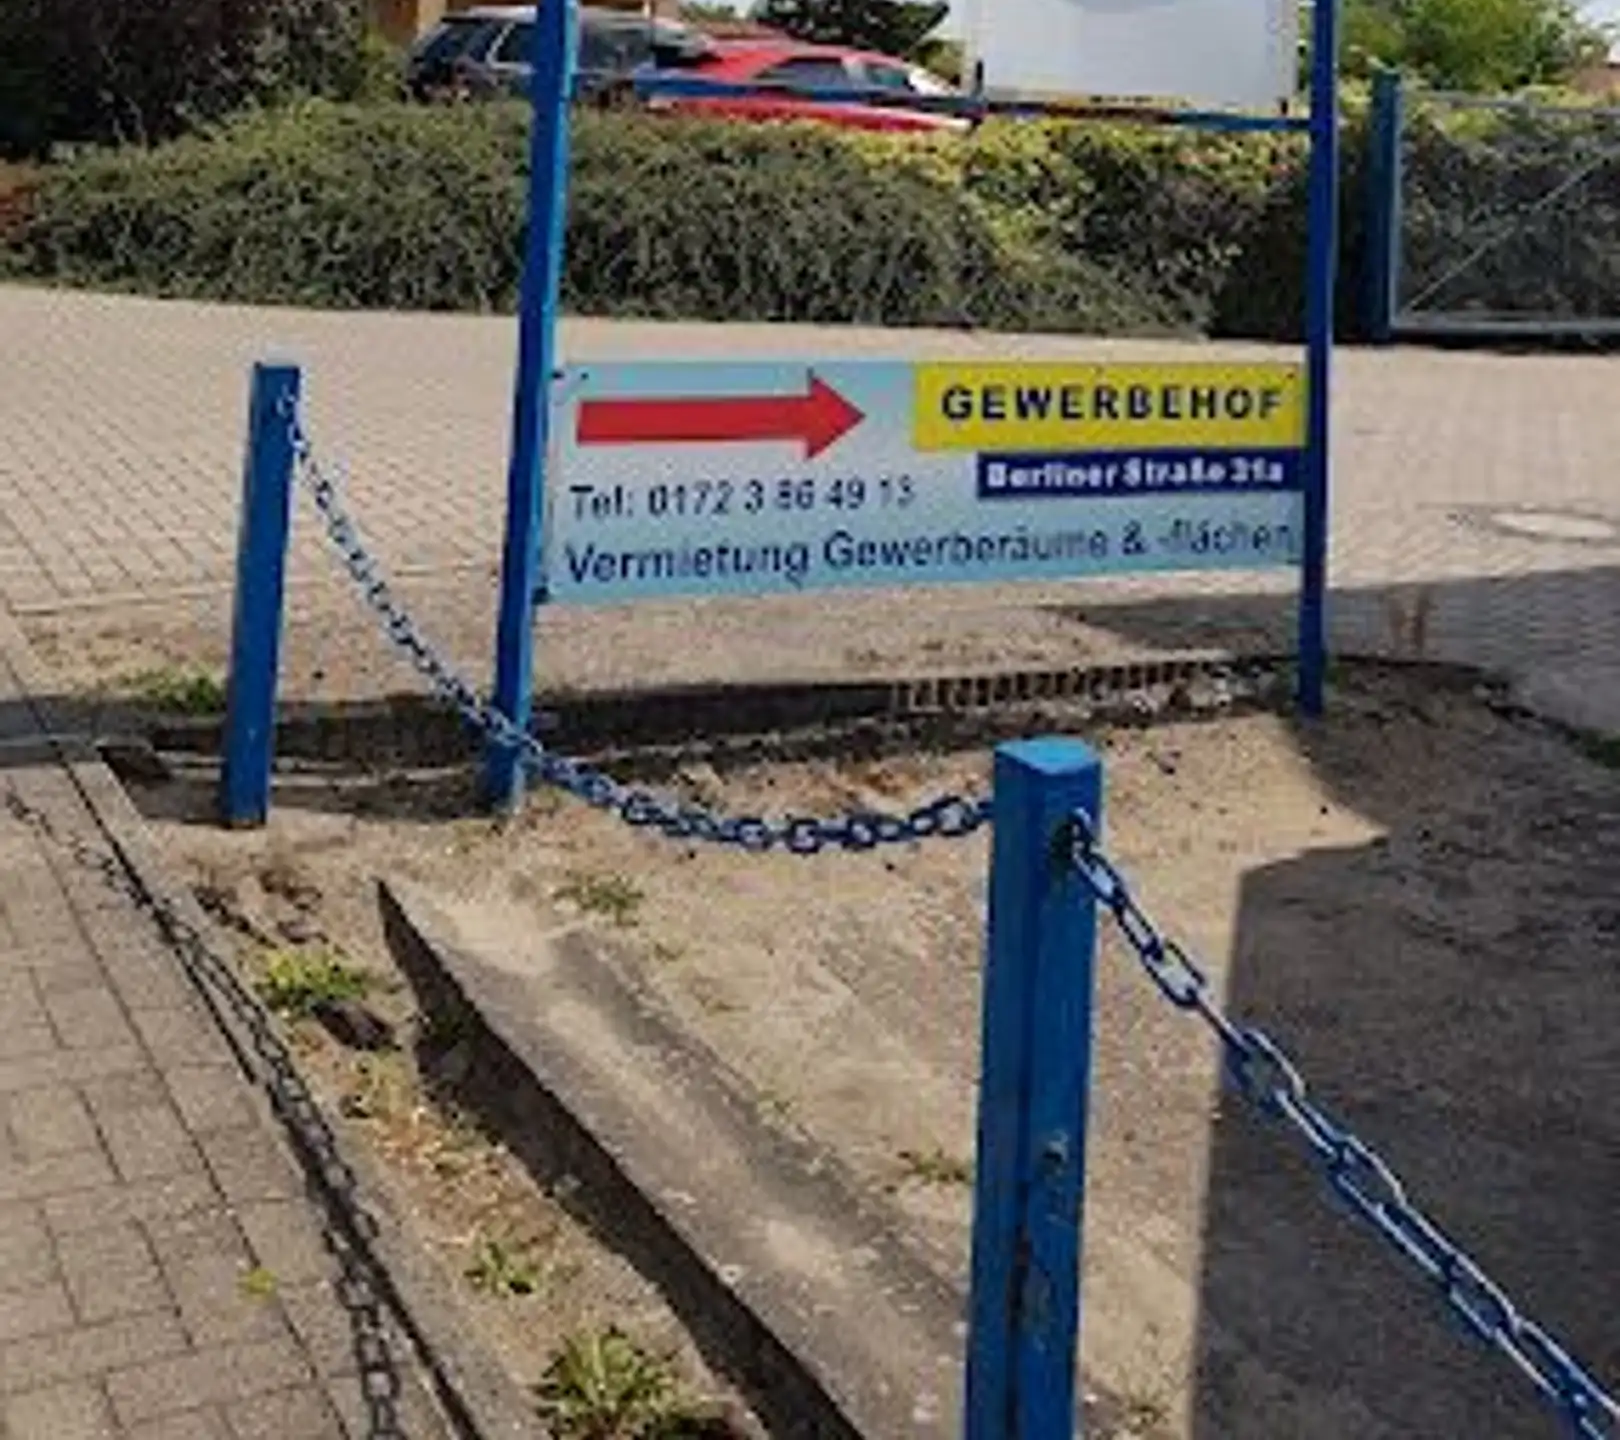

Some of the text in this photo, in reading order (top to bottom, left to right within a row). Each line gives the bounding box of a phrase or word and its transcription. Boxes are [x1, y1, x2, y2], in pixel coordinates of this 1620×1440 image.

[941, 384, 1282, 421] GEWERBEHOF
[985, 461, 1119, 489] Berliner
[569, 483, 634, 520] Tel:
[649, 478, 734, 518] 0172
[827, 476, 867, 511] 49
[565, 540, 810, 591] Vermietung
[823, 524, 1108, 570] Gewerberäume
[1122, 519, 1148, 557] &
